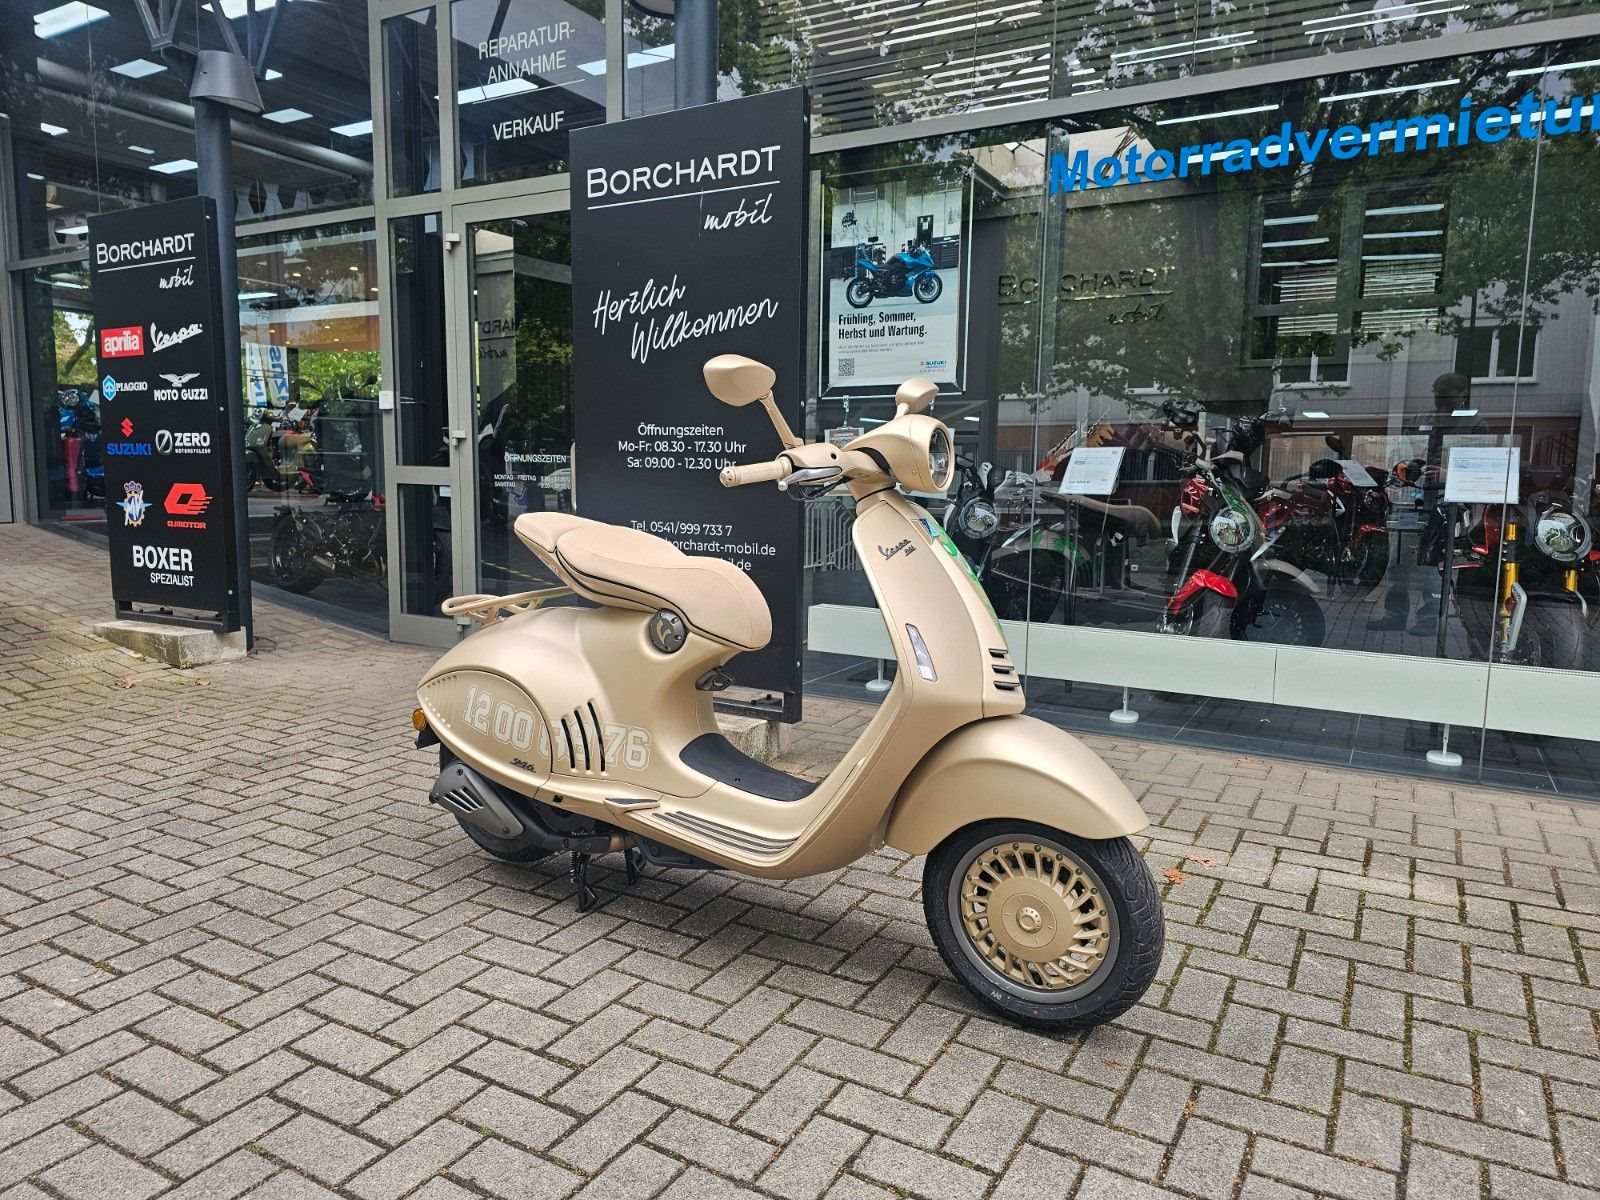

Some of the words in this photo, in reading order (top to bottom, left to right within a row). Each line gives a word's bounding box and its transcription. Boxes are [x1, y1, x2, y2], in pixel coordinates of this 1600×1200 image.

[478, 21, 576, 60] REPARATUR-
[487, 50, 567, 85] ANNAHME
[492, 110, 565, 141] VERKAUF
[704, 193, 773, 230] mobil
[159, 265, 194, 289] mobil
[998, 265, 1176, 298] BOCHARDT
[593, 274, 686, 335] Herzlich
[838, 313, 876, 326] Frühling,
[879, 311, 916, 323] Sommer,
[151, 322, 203, 352] Vespa
[631, 298, 779, 364] Willkommen
[838, 328, 867, 339] Herbst
[869, 326, 885, 338] und
[888, 324, 928, 338] Wartung.
[104, 331, 140, 355] aprilia
[115, 381, 148, 392] PIAGGIO
[153, 390, 178, 401] MOTO
[181, 388, 208, 400] GUZZI
[638, 422, 724, 438] Öffnungszeiten
[174, 432, 210, 447] ZERO
[618, 441, 652, 452] Mo-Fr:
[654, 441, 685, 452] 08.30
[694, 441, 722, 453] 17.30
[724, 441, 747, 453] Uhr
[107, 442, 151, 456] SUZUKI
[627, 457, 643, 468] Sa:
[645, 457, 675, 469] 09.00
[684, 457, 712, 469] 12.30
[630, 520, 648, 532] Tel.
[650, 520, 700, 535] 0541/999
[703, 524, 723, 536] 733
[725, 525, 733, 537] 7
[665, 538, 776, 556] orchardt-mobil.de
[132, 545, 194, 572] BOXER
[150, 572, 195, 587] SPEZIALIST
